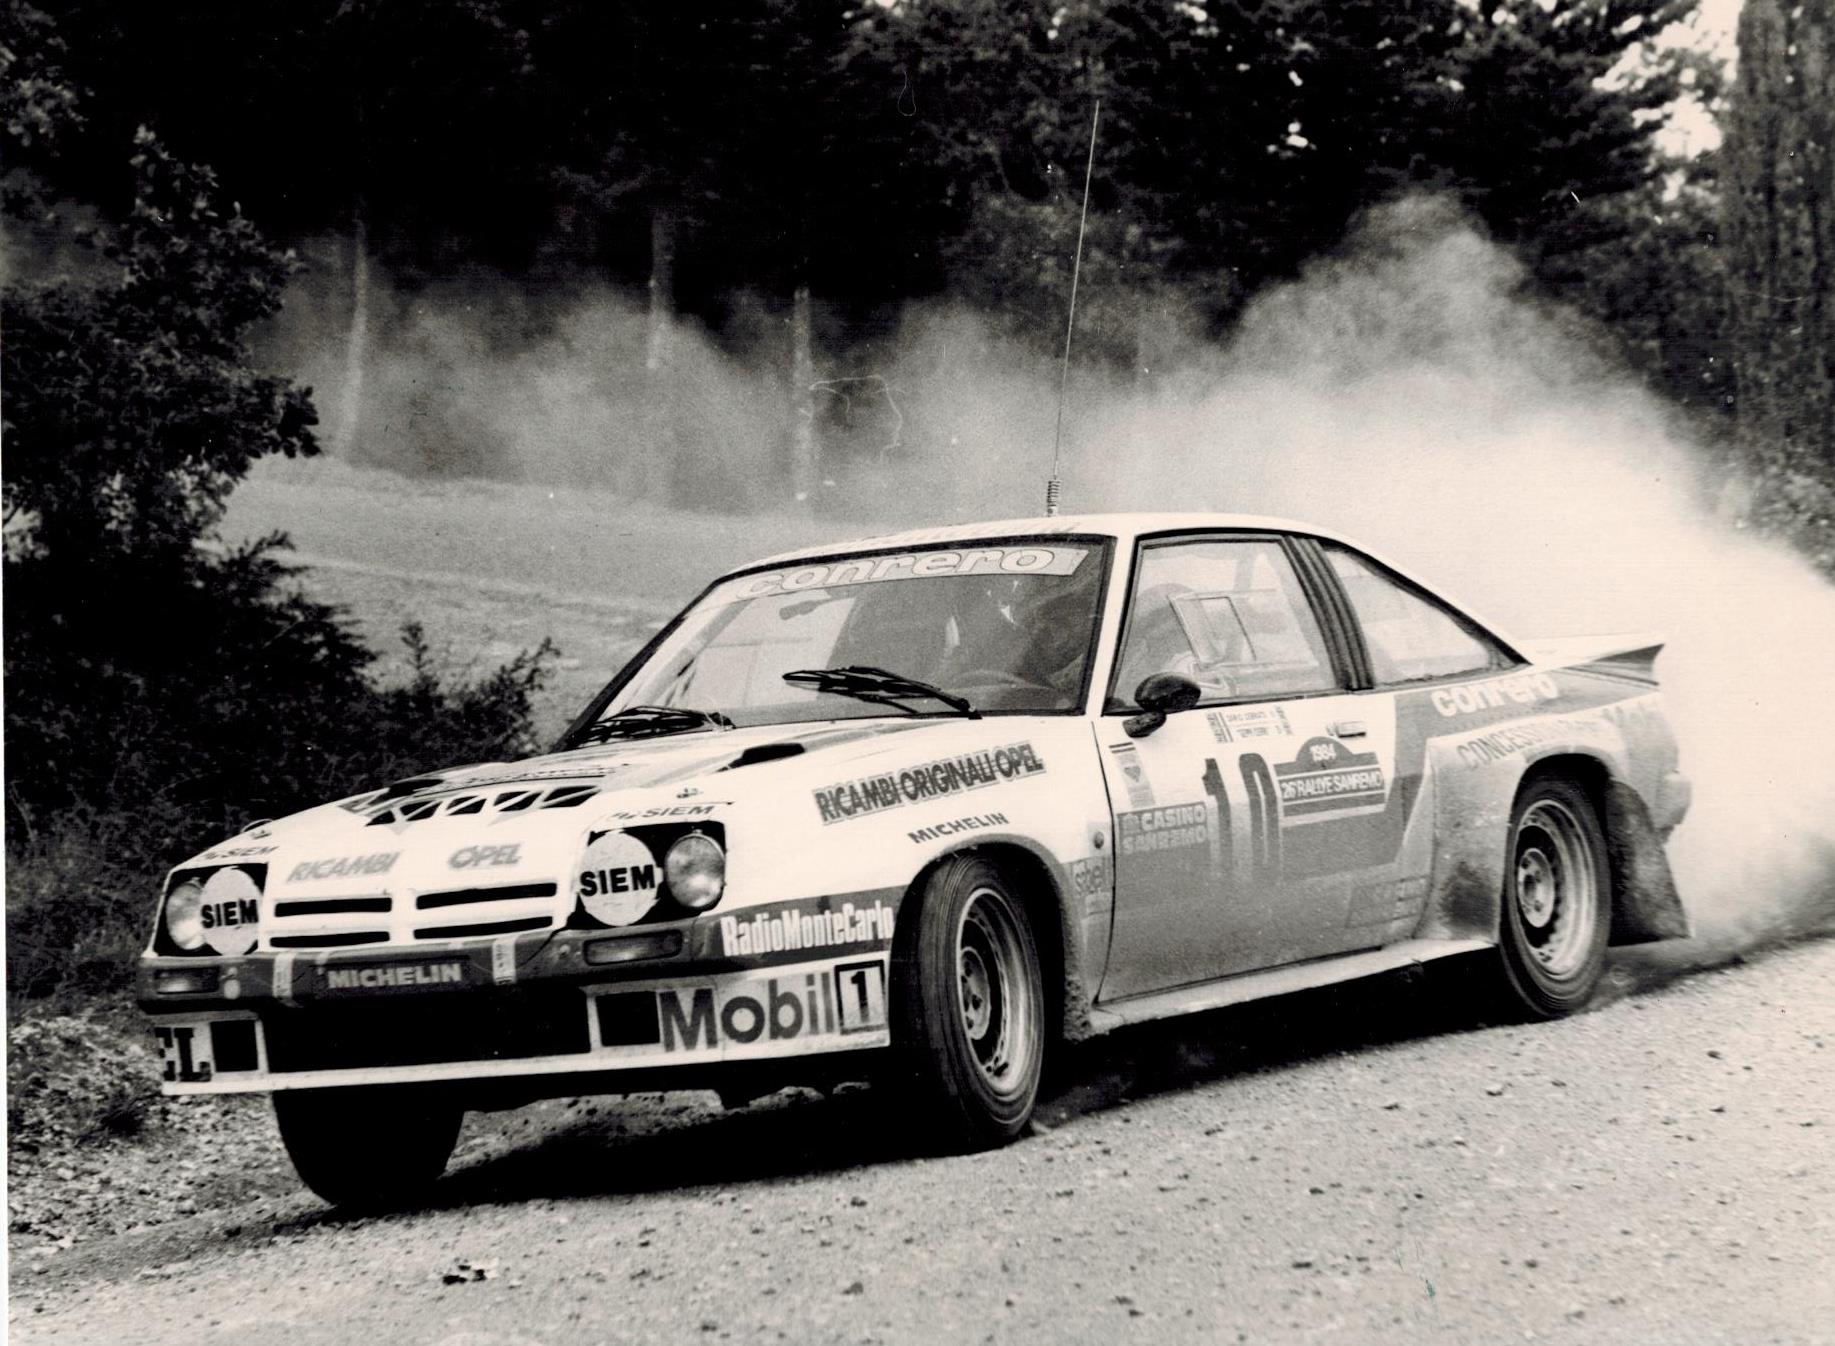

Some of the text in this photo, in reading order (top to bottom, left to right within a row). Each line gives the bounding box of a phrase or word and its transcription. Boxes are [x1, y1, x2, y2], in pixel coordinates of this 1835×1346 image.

[736, 547, 1056, 599] conrero
[1309, 743, 1337, 763] 1984
[815, 742, 1044, 822] RICAMBI ORIGINALI OPEL
[907, 812, 1010, 843] MICHELIN
[1141, 804, 1206, 832] CASINO
[286, 843, 522, 883] RICAMBI OPEL
[580, 864, 656, 896] SIEM
[201, 898, 260, 929] SIEM
[328, 962, 463, 989] MICHELIN
[659, 972, 835, 1052] Mobil
